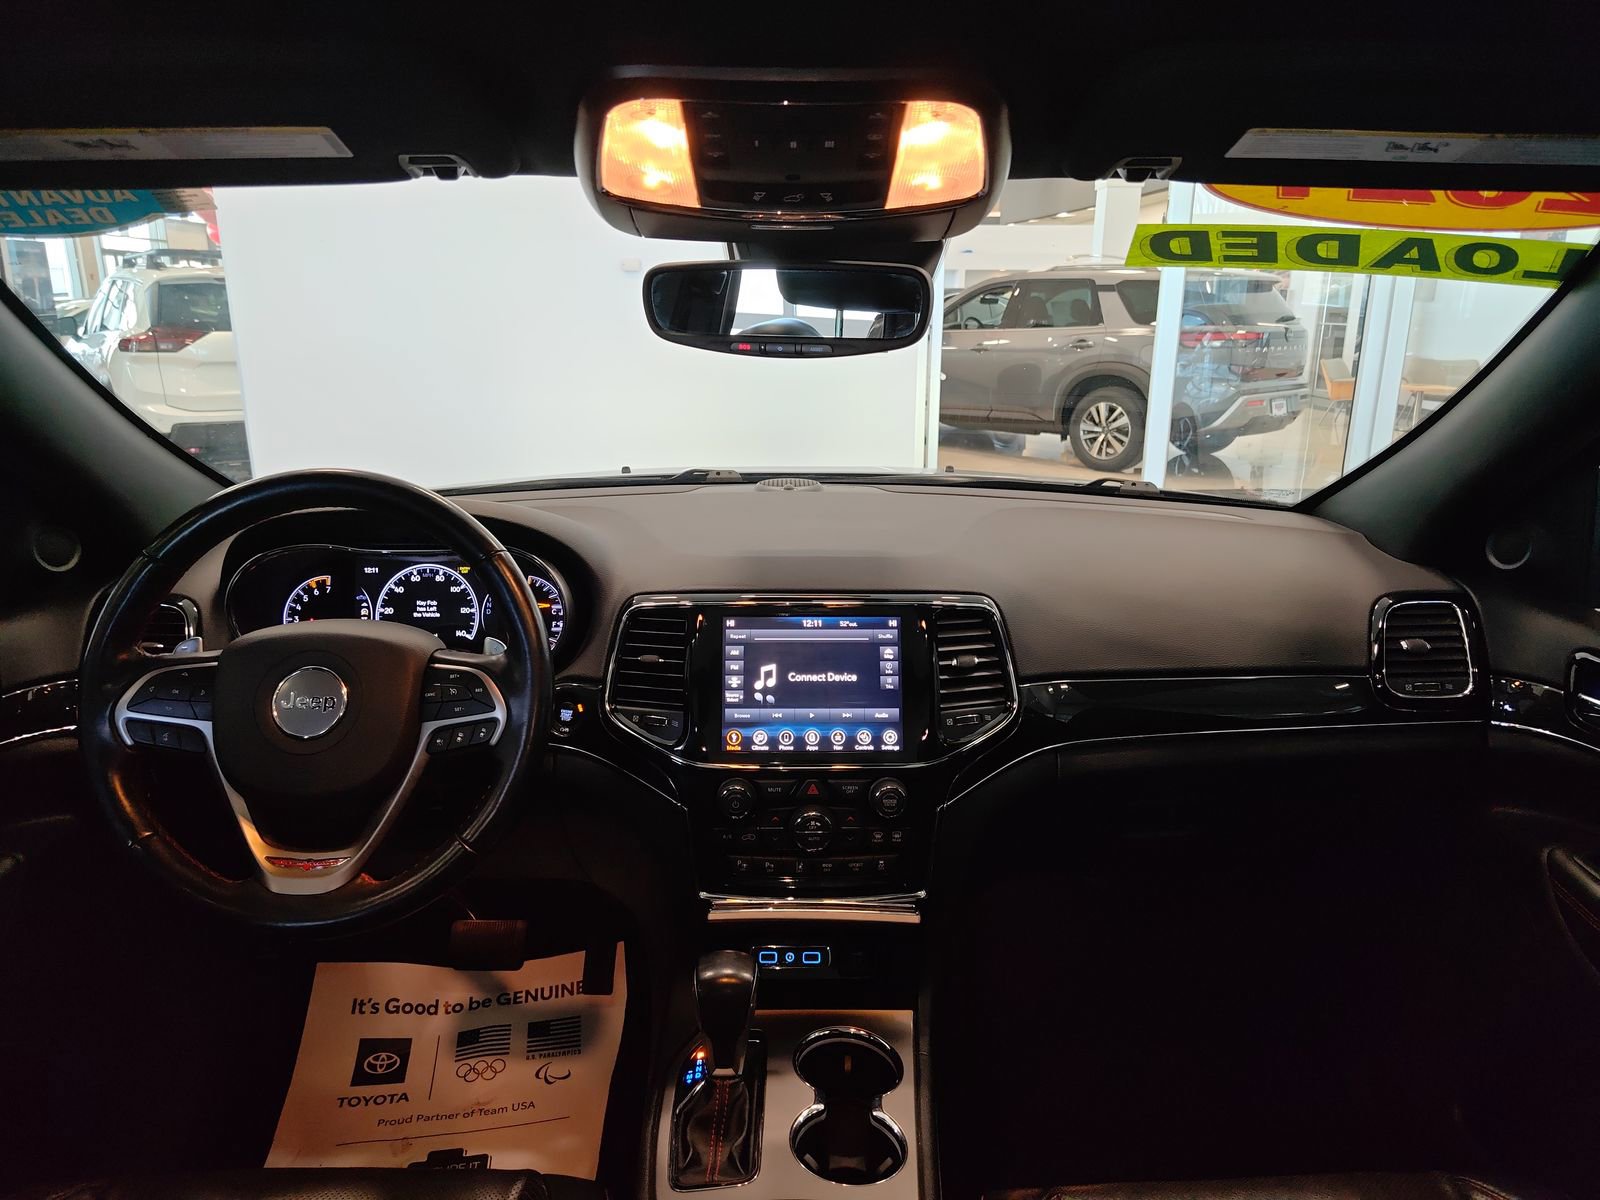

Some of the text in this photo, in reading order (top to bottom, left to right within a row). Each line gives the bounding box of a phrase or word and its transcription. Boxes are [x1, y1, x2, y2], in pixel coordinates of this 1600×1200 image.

[314, 588, 320, 596] 6
[326, 586, 331, 594] 7
[293, 615, 299, 623] 3
[802, 619, 822, 627] 12:11
[788, 671, 857, 682] Connect Device
[281, 690, 337, 713] Jeep
[351, 997, 381, 1016] It's
[384, 997, 440, 1016] Good
[443, 1001, 465, 1015] to
[468, 993, 493, 1011] be
[337, 1092, 410, 1109] TOYOTA
[377, 1101, 536, 1128] Proud Partner of Team USA
